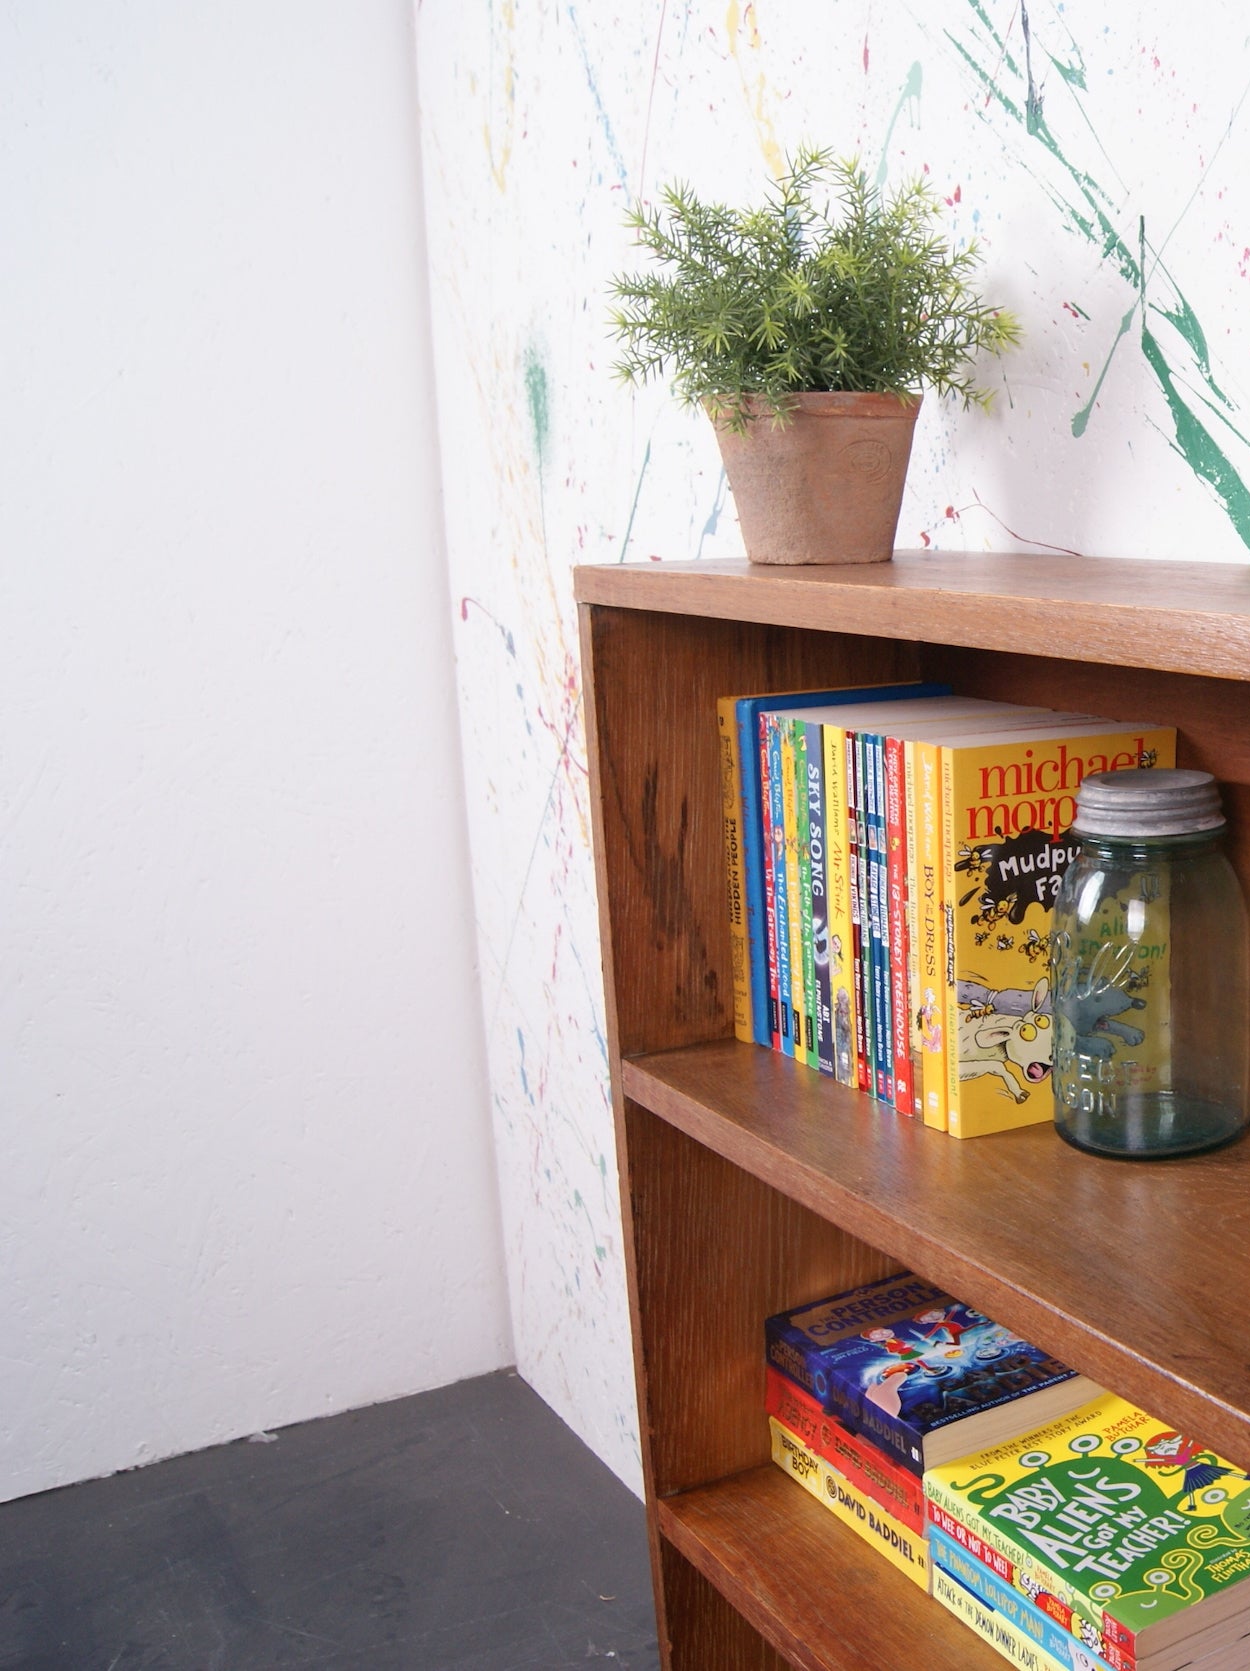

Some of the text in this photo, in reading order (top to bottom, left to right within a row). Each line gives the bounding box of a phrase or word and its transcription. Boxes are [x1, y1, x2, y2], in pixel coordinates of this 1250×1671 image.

[771, 750, 780, 781] Enid
[808, 763, 824, 896] SKY SONG
[944, 762, 953, 884] michael morpurgo
[966, 795, 1077, 843] morp
[729, 818, 741, 925] HIDDEN PEOPLE
[832, 841, 845, 920] Mr Stink
[924, 865, 935, 905] BOY
[999, 844, 1081, 881] Mudpu
[1035, 872, 1062, 901] Fa
[778, 895, 788, 961] Enchanted
[892, 884, 902, 966] 13-STOREY
[925, 917, 936, 976] DRESS
[894, 971, 905, 1059] TREEHOUSE
[950, 1037, 958, 1097] Invasion!
[806, 1287, 949, 1337] CONTROLLE
[834, 1281, 925, 1319] PERSON
[910, 1359, 1069, 1422] BADDIE
[930, 1404, 981, 1427] BESTSELLING
[981, 1395, 1010, 1409] AUTHOR
[1022, 1384, 1038, 1394] THE
[1039, 1373, 1068, 1388] PARENT
[937, 1353, 1032, 1392] DAVID
[863, 1408, 907, 1455] BADDIEL
[969, 1410, 1103, 1471] BLUE PETER BEST STORY AWARD
[980, 1414, 1082, 1460] FROM THE WINNERS OF THE
[1102, 1411, 1142, 1434] PAMELA
[1105, 1418, 1150, 1442] BUTCHAR
[779, 1433, 819, 1474] BIRTHDAY
[792, 1457, 810, 1479] BOY
[838, 1486, 915, 1563] DAVID BADDIEL
[926, 1482, 1024, 1564] BABY ALIENS GOT MY TEACHER!
[989, 1477, 1067, 1530] BABY
[1016, 1476, 1142, 1570] ALIENS
[1112, 1505, 1148, 1529] MY
[940, 1513, 956, 1536] WEE
[956, 1526, 968, 1543] OR
[968, 1534, 982, 1554] NOT
[992, 1554, 1008, 1578] WEE!
[1072, 1509, 1192, 1580] TEACHER!
[1204, 1548, 1250, 1574] THOMAS
[934, 1538, 947, 1561] THE
[985, 1579, 1019, 1617] LOLLIPOP
[1020, 1604, 1045, 1644] MAN!
[936, 1578, 956, 1604] ATTACK
[975, 1610, 995, 1640] DEMON
[996, 1624, 1016, 1656] DINNER
